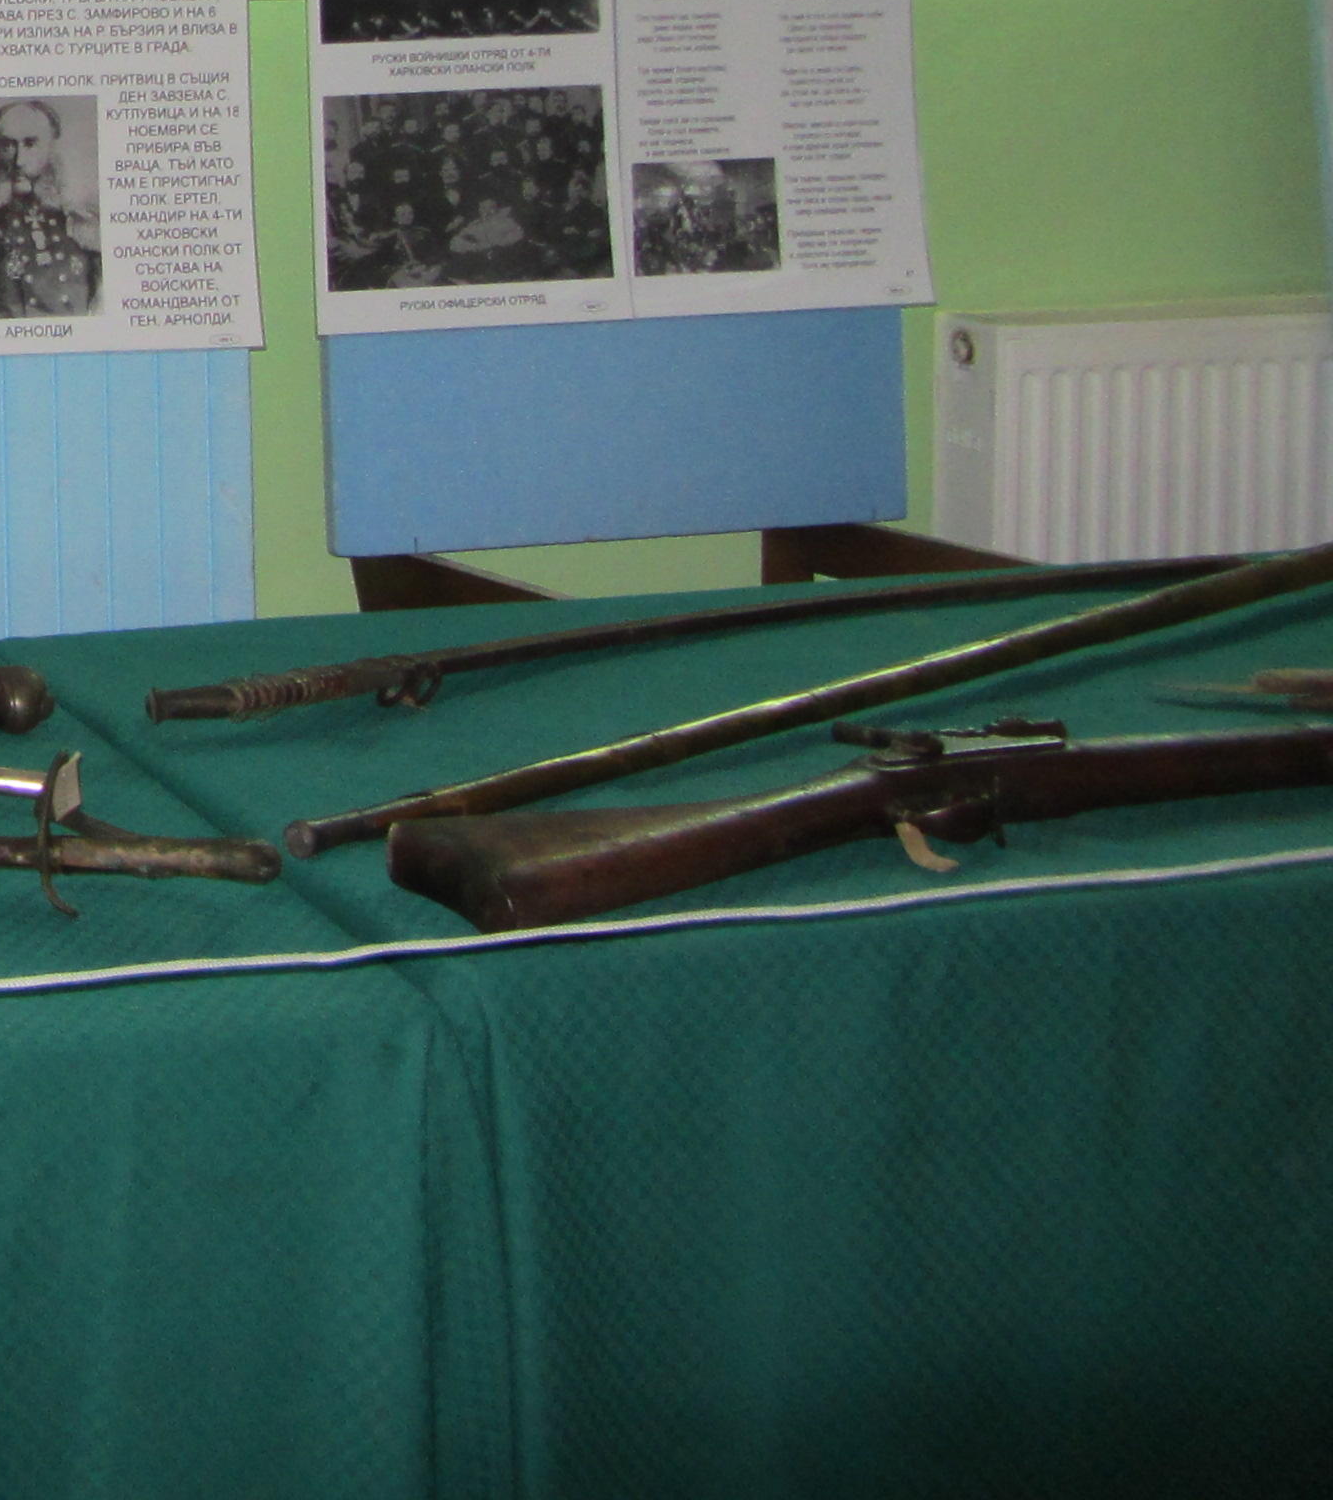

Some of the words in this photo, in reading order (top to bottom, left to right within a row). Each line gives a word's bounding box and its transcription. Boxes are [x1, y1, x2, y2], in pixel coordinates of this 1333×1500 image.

[188, 106, 199, 118] И
[202, 106, 221, 118] НА
[226, 106, 239, 117] 18
[128, 123, 196, 136] НОЕМВРИ
[199, 123, 218, 135] СЕ
[125, 141, 190, 154] ПРИБИРА
[193, 140, 221, 152] ВЪВ
[109, 210, 186, 224] КОМАНДИР
[189, 209, 209, 221] НА
[136, 226, 217, 239] ХАРКОВСКИ
[112, 244, 179, 257] ОЛАНСКИ
[182, 243, 220, 256] ПОЛК
[222, 243, 242, 255] ОТ
[135, 261, 200, 274] СЪСТАВА
[203, 261, 223, 273] НА
[121, 295, 217, 311] КОМАНДВАНИ
[220, 294, 239, 307] ОТ
[4, 324, 72, 340] АРНОЛДИ
